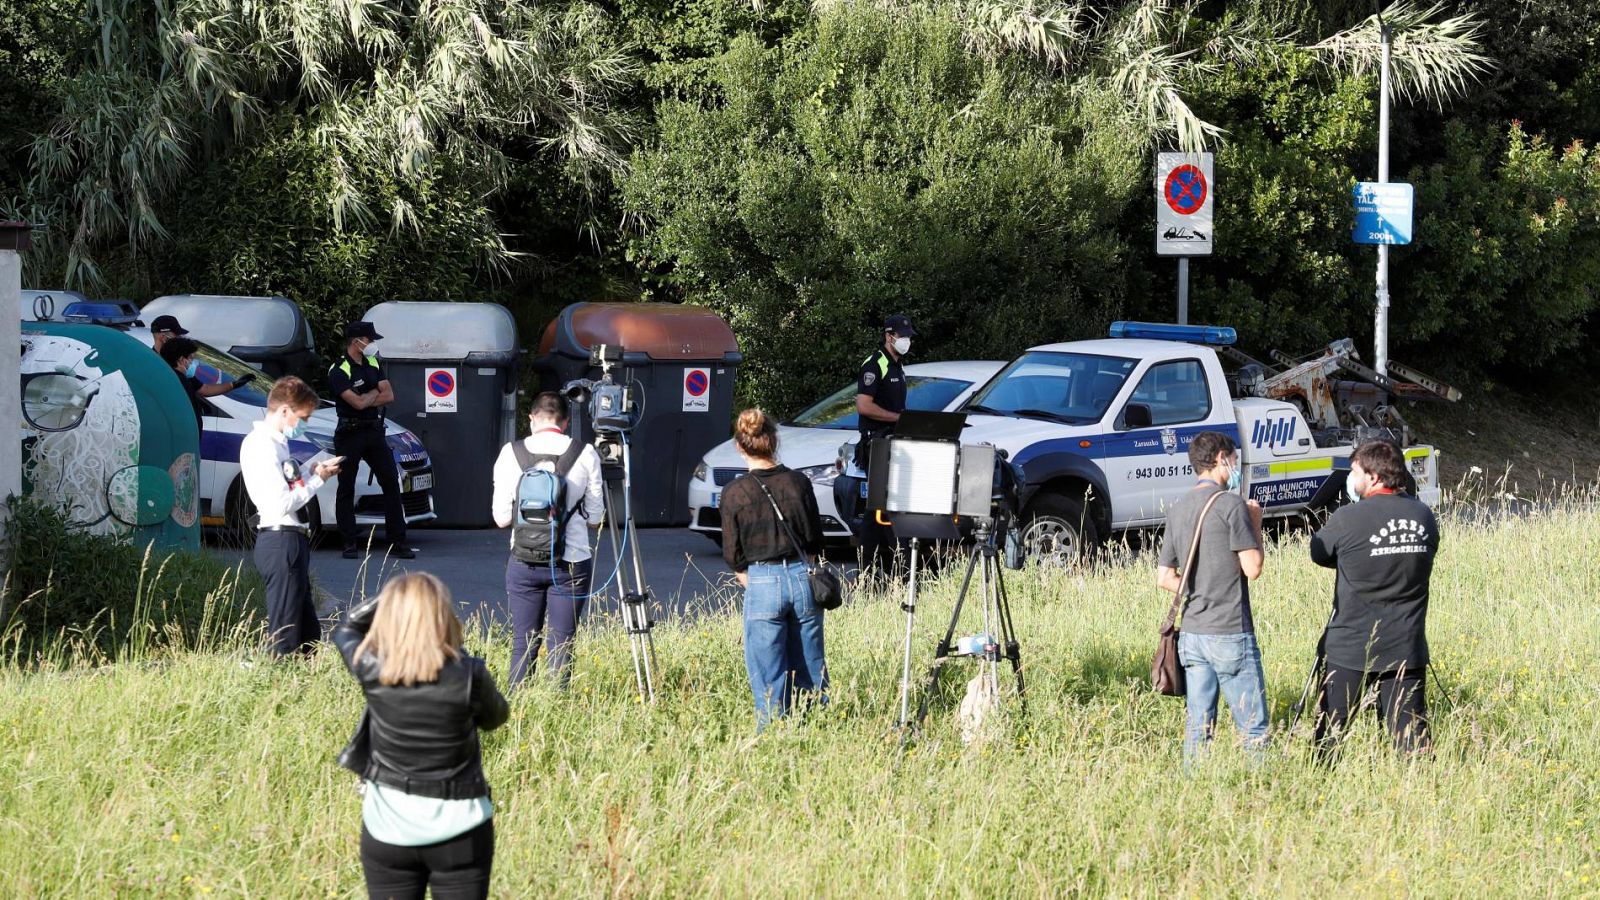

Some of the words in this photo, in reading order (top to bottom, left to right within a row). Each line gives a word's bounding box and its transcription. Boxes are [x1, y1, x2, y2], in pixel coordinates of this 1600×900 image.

[1136, 467, 1152, 478] 943
[1154, 466, 1165, 477] 00
[1168, 465, 1178, 476] 51
[1181, 464, 1193, 475] 15
[1257, 484, 1277, 495] GRUA
[1278, 480, 1318, 492] MUNICIPAL
[1277, 490, 1309, 500] GARABIA
